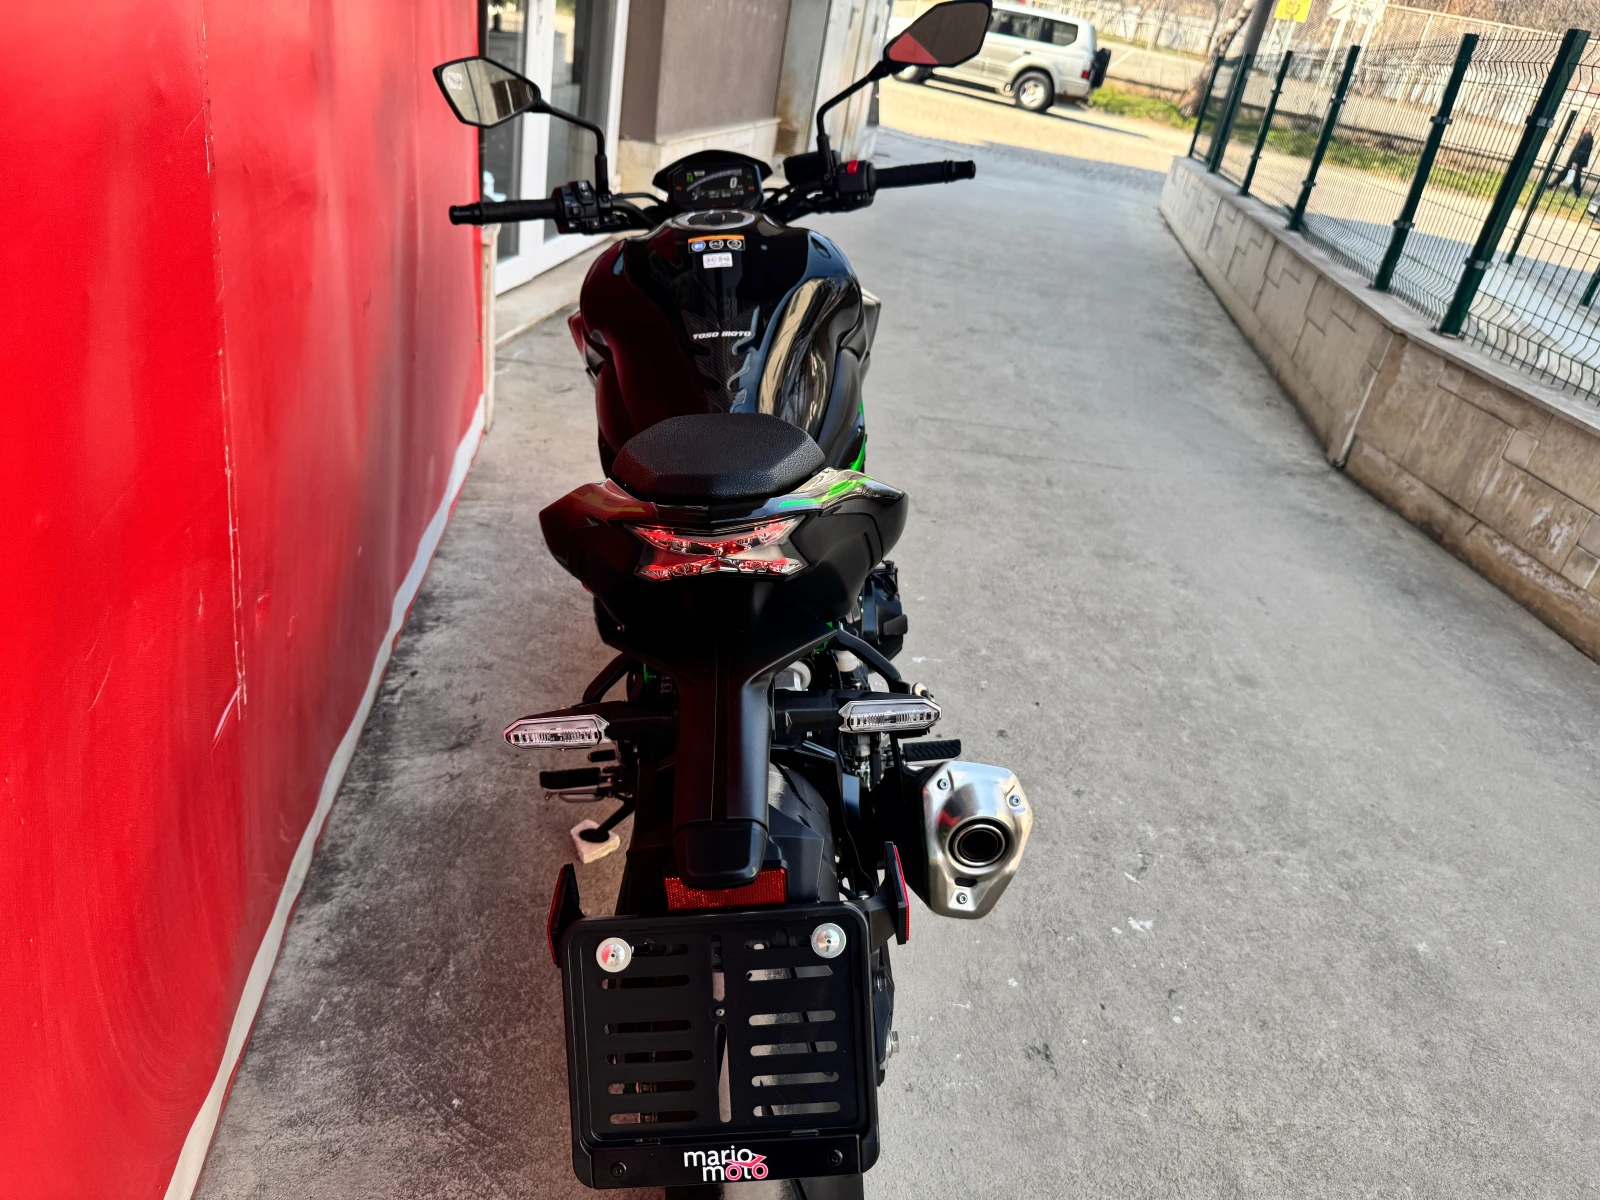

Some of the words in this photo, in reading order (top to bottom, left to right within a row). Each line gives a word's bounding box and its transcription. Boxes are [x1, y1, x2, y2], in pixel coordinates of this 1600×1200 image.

[730, 177, 738, 189] 0
[684, 1144, 752, 1167] mario
[702, 1162, 768, 1181] moto
